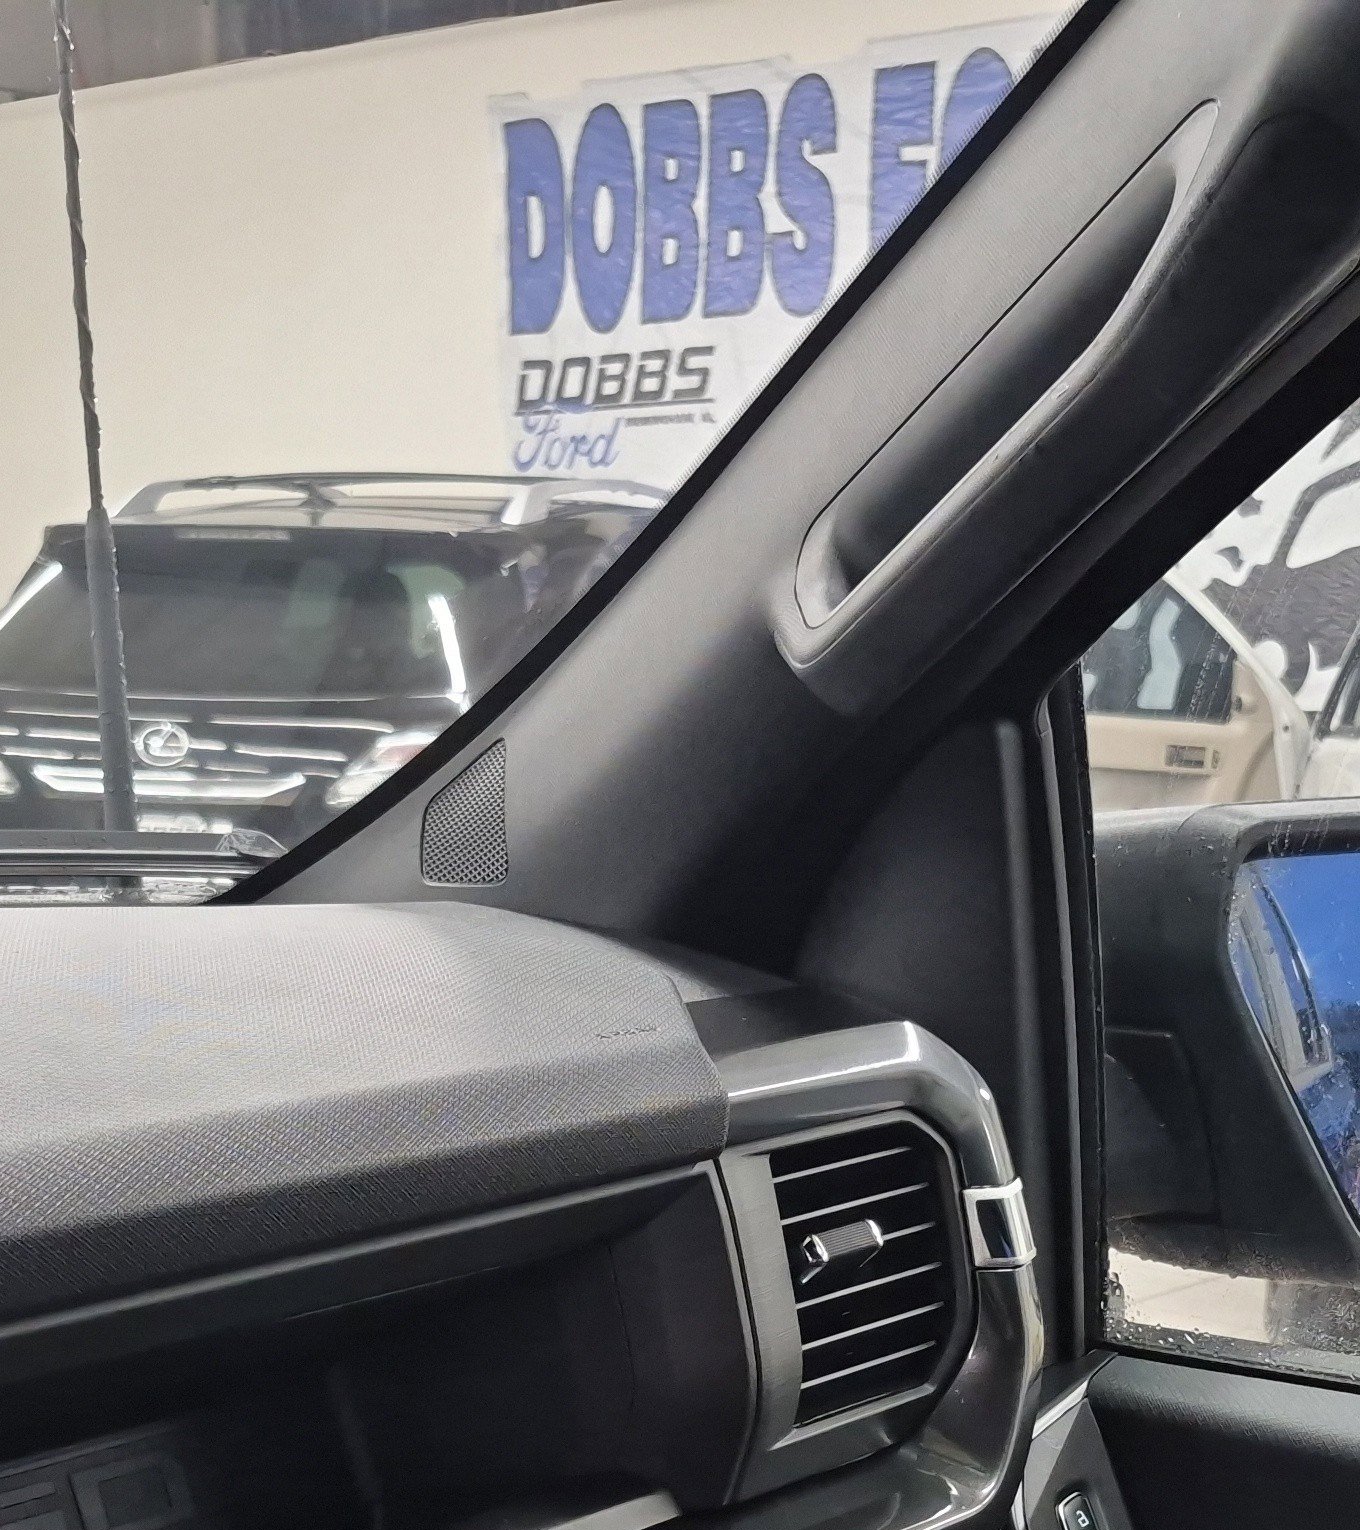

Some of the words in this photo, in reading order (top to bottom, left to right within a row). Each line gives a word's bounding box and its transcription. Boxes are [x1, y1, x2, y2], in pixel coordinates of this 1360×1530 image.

[503, 72, 839, 336] DOBBS
[516, 345, 716, 414] DOBBS
[512, 402, 622, 473] Ford
